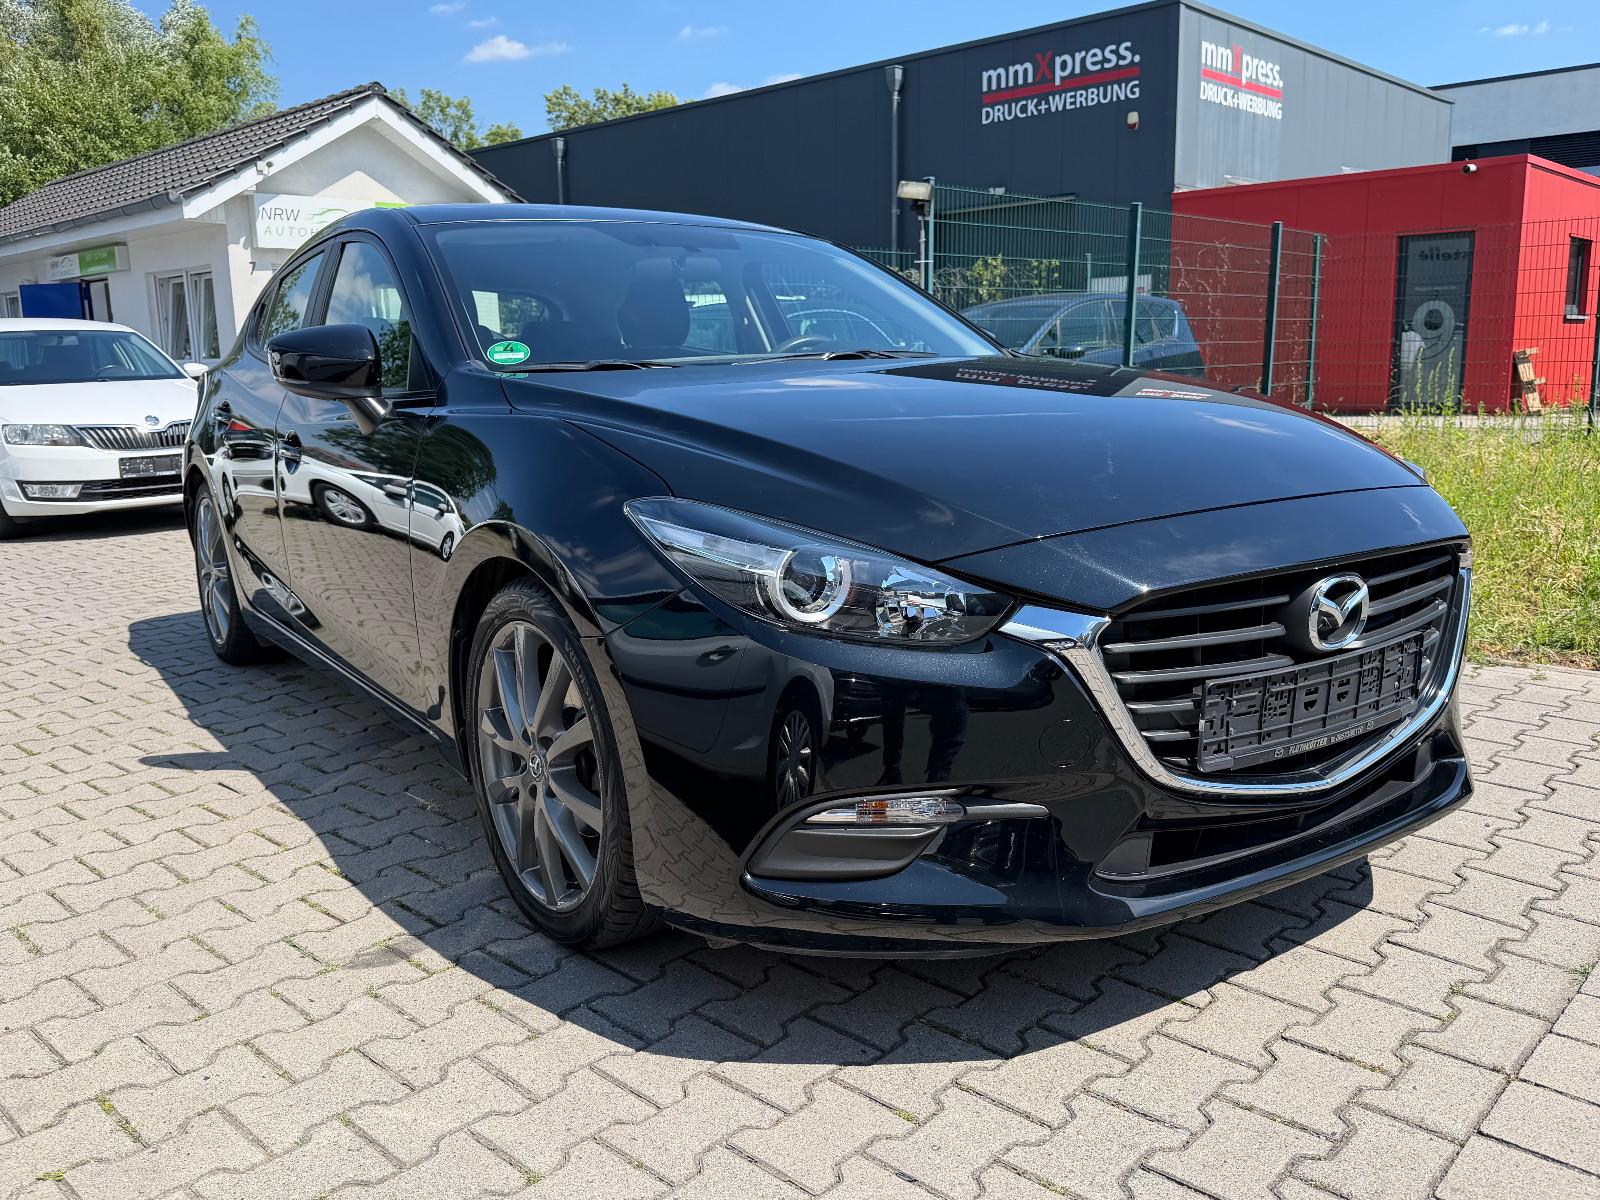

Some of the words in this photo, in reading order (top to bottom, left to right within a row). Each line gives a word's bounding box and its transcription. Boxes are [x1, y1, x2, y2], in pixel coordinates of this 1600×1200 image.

[981, 41, 1141, 93] mmXpress.
[1201, 40, 1283, 87] mmXpress.
[981, 80, 1140, 125] DRUCK+WERBUNG
[1200, 81, 1283, 120] DRUCK+WERBUNG
[261, 207, 301, 222] NRW
[248, 261, 257, 275] 7
[503, 342, 515, 353] 4
